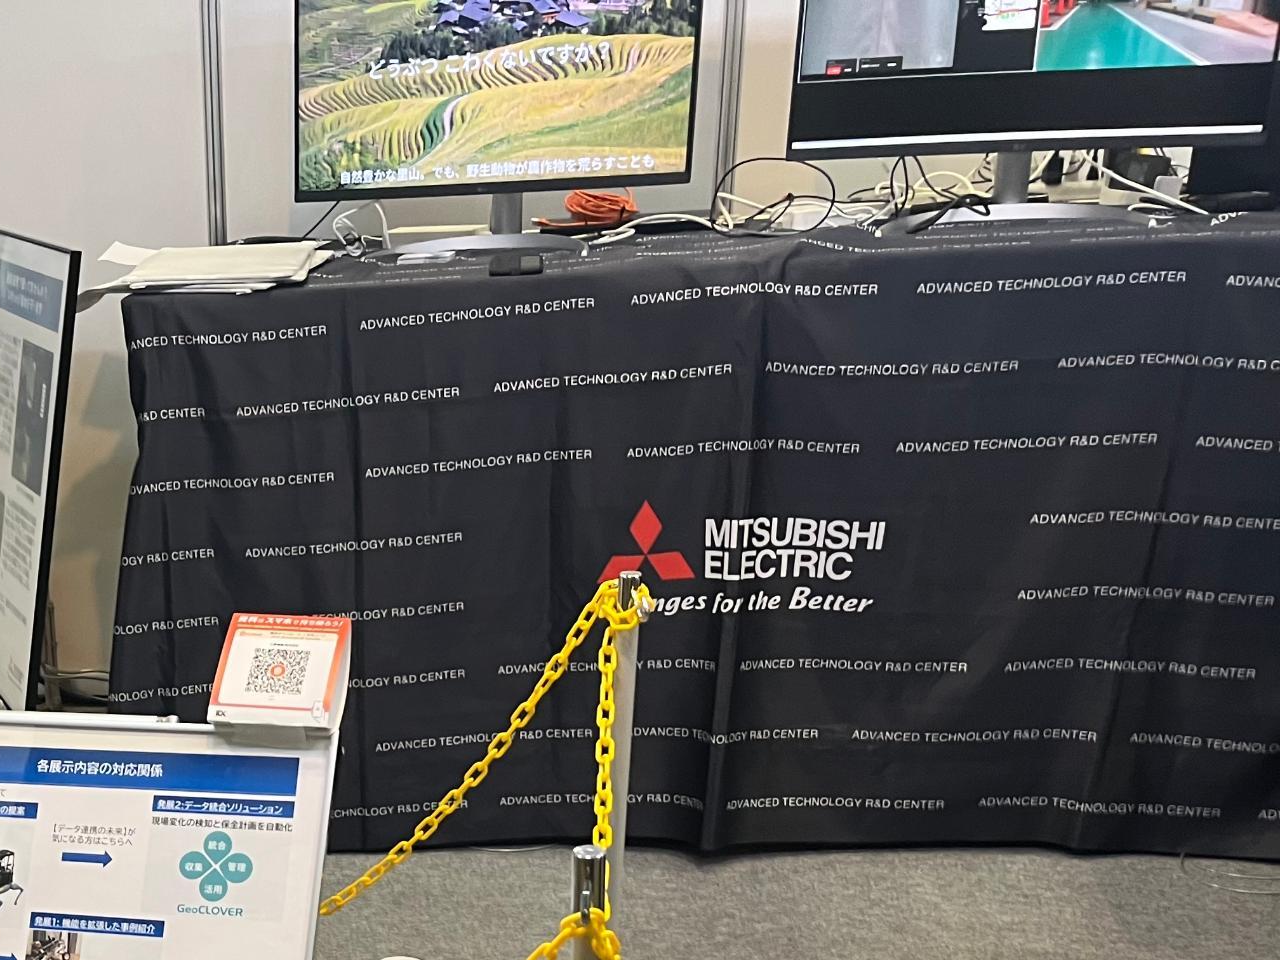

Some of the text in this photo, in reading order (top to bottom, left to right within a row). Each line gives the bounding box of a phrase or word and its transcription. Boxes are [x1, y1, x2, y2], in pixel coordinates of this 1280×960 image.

[917, 271, 1186, 293] ADVANCED TECHNOLOGY R&D CENTER
[631, 282, 878, 305] ADVANCED TECHNOLOGY R&D CENTER
[360, 298, 594, 330] ADVANCED TECHNOLOGY R&D CENTER
[171, 333, 248, 344] TECHNOLOGY
[253, 331, 276, 341] R&D
[279, 325, 326, 339] CENTER
[766, 361, 1018, 375] ADVANCED TECHNOLOGY R&D CENTER
[1058, 355, 1135, 368] ADVANCED
[1140, 354, 1234, 367] TECHNOLOGY
[1238, 359, 1266, 369] R&D
[494, 364, 731, 392] ADVANCED TECHNOLOGY R&D CENTER
[237, 387, 459, 416] ADVANCED TECHNOLOGY R&D CENTER
[160, 408, 205, 419] CENTER
[627, 439, 859, 457] ADVANCED TECHNOLOGY R&D CENTER
[896, 433, 1157, 452] ADVANCED TECHNOLOGY R&D CENTER
[1196, 436, 1273, 450] ADVANCED
[366, 450, 591, 478] ADVANCED TECHNOLOGY R&D CENTER
[184, 478, 258, 488] TECHNOLOGY
[262, 476, 285, 486] R&D
[288, 472, 334, 484] CENTER
[1030, 512, 1104, 524] ADVANCED
[1109, 511, 1199, 524] TECHNOLOGY
[1204, 515, 1232, 527] R&D
[704, 517, 886, 550] MITSUBISHI
[246, 532, 462, 557] ADVANCED TECHNOLOGY R&D CENTER
[147, 549, 214, 563] R&D CENTER
[704, 549, 853, 581] ELECTRIC
[649, 586, 873, 616] nges for the Better
[1018, 586, 1274, 606] ADVANCED TECHNOLOGY R&D CENTER
[392, 602, 464, 617] R&D CENTER
[152, 621, 173, 630] R&D
[177, 617, 218, 629] CENTER
[648, 659, 714, 669] R&D CENTER
[740, 659, 967, 672] ADVANCED TECHNOLOGY R&D CENTER
[1005, 658, 1255, 678] ADVANCED TECHNOLOGY R&D CENTER
[394, 669, 465, 684] R&D CENTER
[158, 688, 179, 696] R&D
[376, 729, 592, 752] ADVANCED R&D CENTER
[750, 730, 770, 739] R&D
[773, 729, 818, 738] CENTER
[852, 729, 1096, 742] ADVANCED TECHNOLOGY R&D CENTER
[1130, 733, 1201, 747] ADVANCED
[37, 759, 163, 778] 各展示内容の対応関係
[500, 794, 561, 805] ADVANCED
[647, 794, 670, 802] R&D
[727, 797, 944, 809] ADVANCED TECHNOLOGY R&D CENTER
[979, 797, 1220, 817] ADVANCED TECHNOLOGY R&D CENTER
[398, 804, 420, 813] R&D
[152, 816, 293, 832] 現場変化の検知と保全計画を自動化
[52, 833, 133, 847] 気になる方はこちらへ
[177, 903, 244, 917] GeoCLOVER
